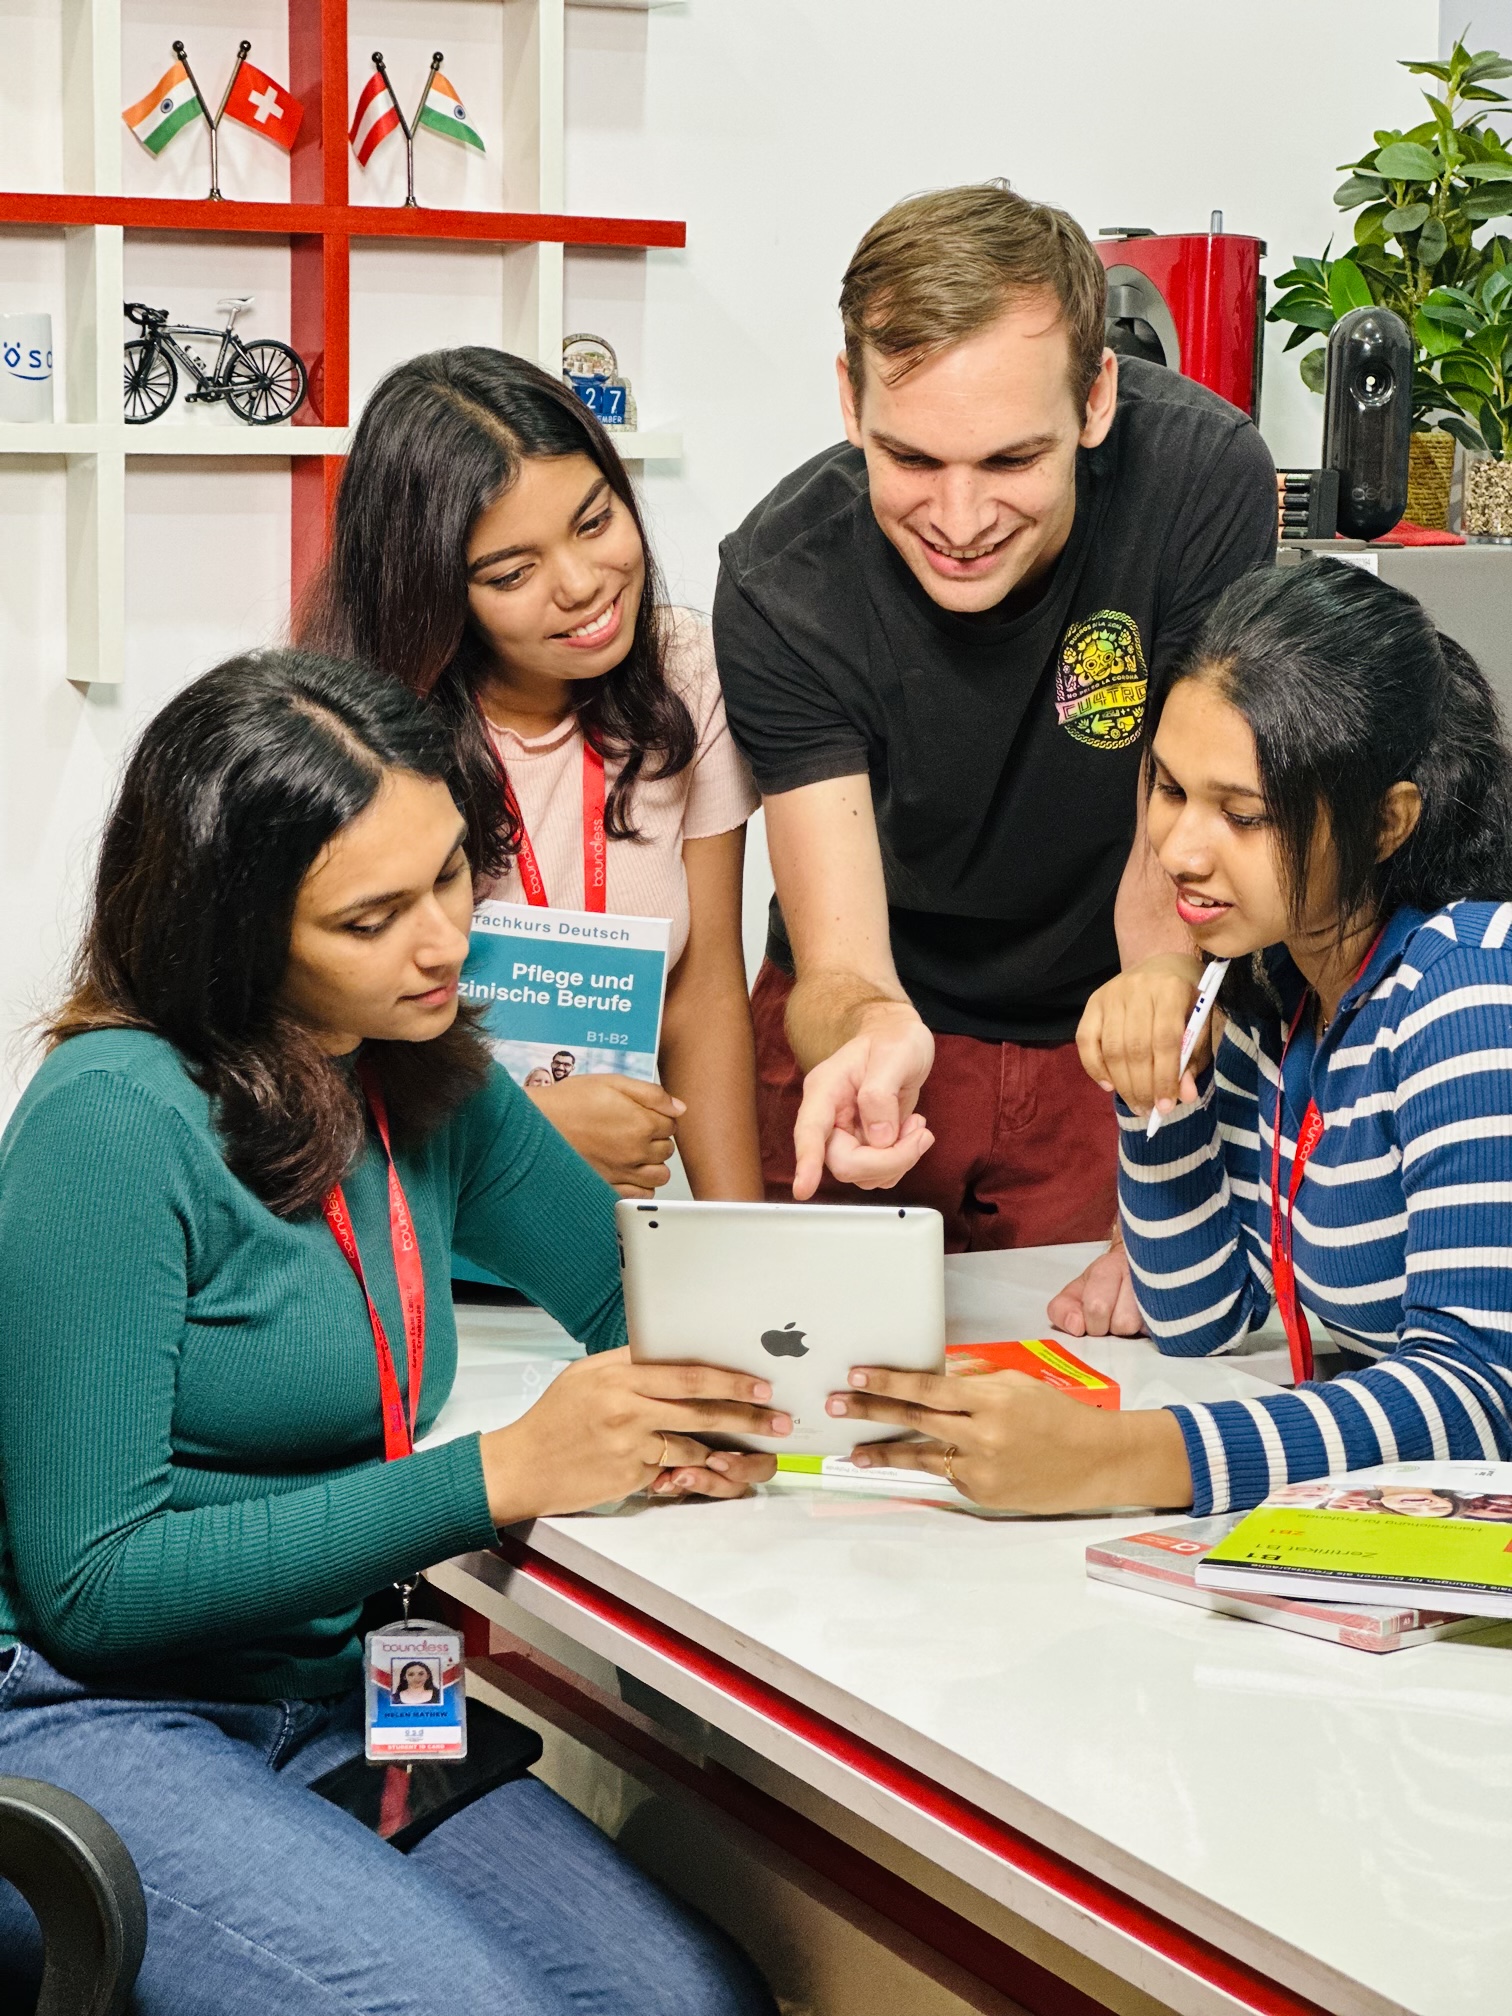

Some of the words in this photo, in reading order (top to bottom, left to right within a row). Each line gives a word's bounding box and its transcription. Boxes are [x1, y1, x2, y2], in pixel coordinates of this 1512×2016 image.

[589, 818, 604, 888] boundless
[558, 922, 631, 941] Deutsch
[512, 962, 584, 989] Pflege
[590, 974, 634, 991] und
[557, 989, 632, 1012] Berufe
[586, 1030, 629, 1045] B1-B2
[391, 1176, 414, 1251] boundless
[1269, 1528, 1305, 1536] ZB1
[1256, 1543, 1281, 1551] B1
[1288, 1545, 1378, 1559] Zertifikat
[1246, 1552, 1282, 1561] B1
[1250, 1562, 1333, 1576] Fremdsprache
[1357, 1571, 1405, 1582] Deutsch
[382, 1639, 449, 1652] boundless
